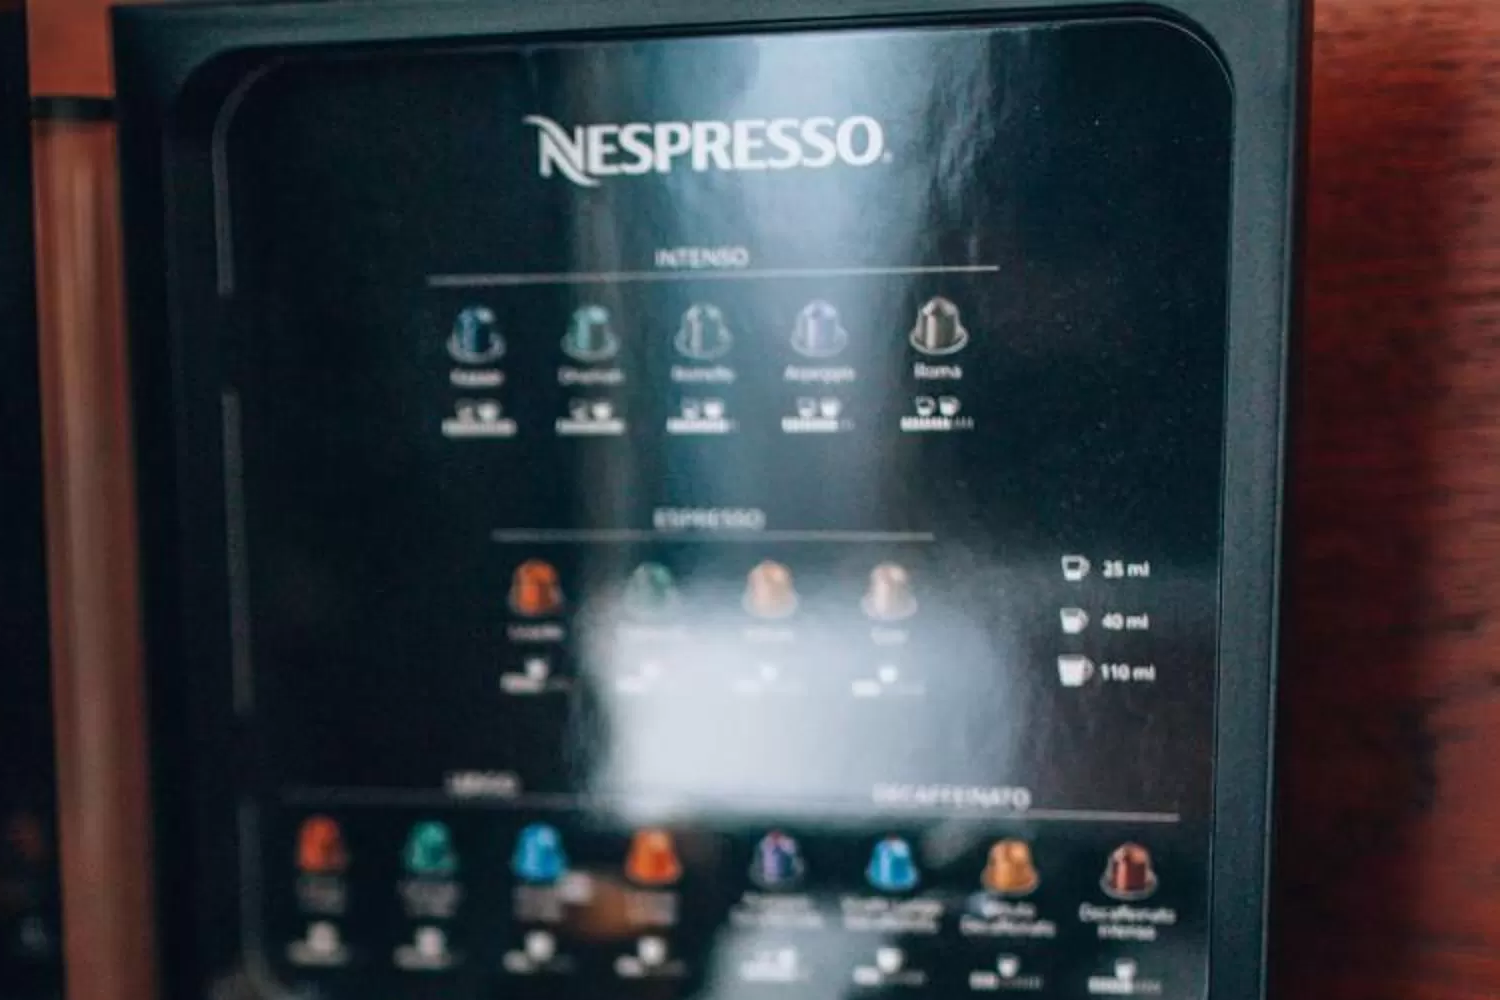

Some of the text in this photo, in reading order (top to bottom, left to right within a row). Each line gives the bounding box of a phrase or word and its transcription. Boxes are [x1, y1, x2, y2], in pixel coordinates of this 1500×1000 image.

[522, 113, 885, 188] NESPRESSO
[654, 247, 749, 269] INTENSO
[912, 362, 960, 380] Roma
[653, 507, 766, 530] ESPRESSO
[1102, 560, 1150, 579] 25 ml
[1101, 612, 1149, 631] 40 ml
[1100, 663, 1156, 682] 110 ml
[872, 783, 1031, 811] DECAFFEINATO
